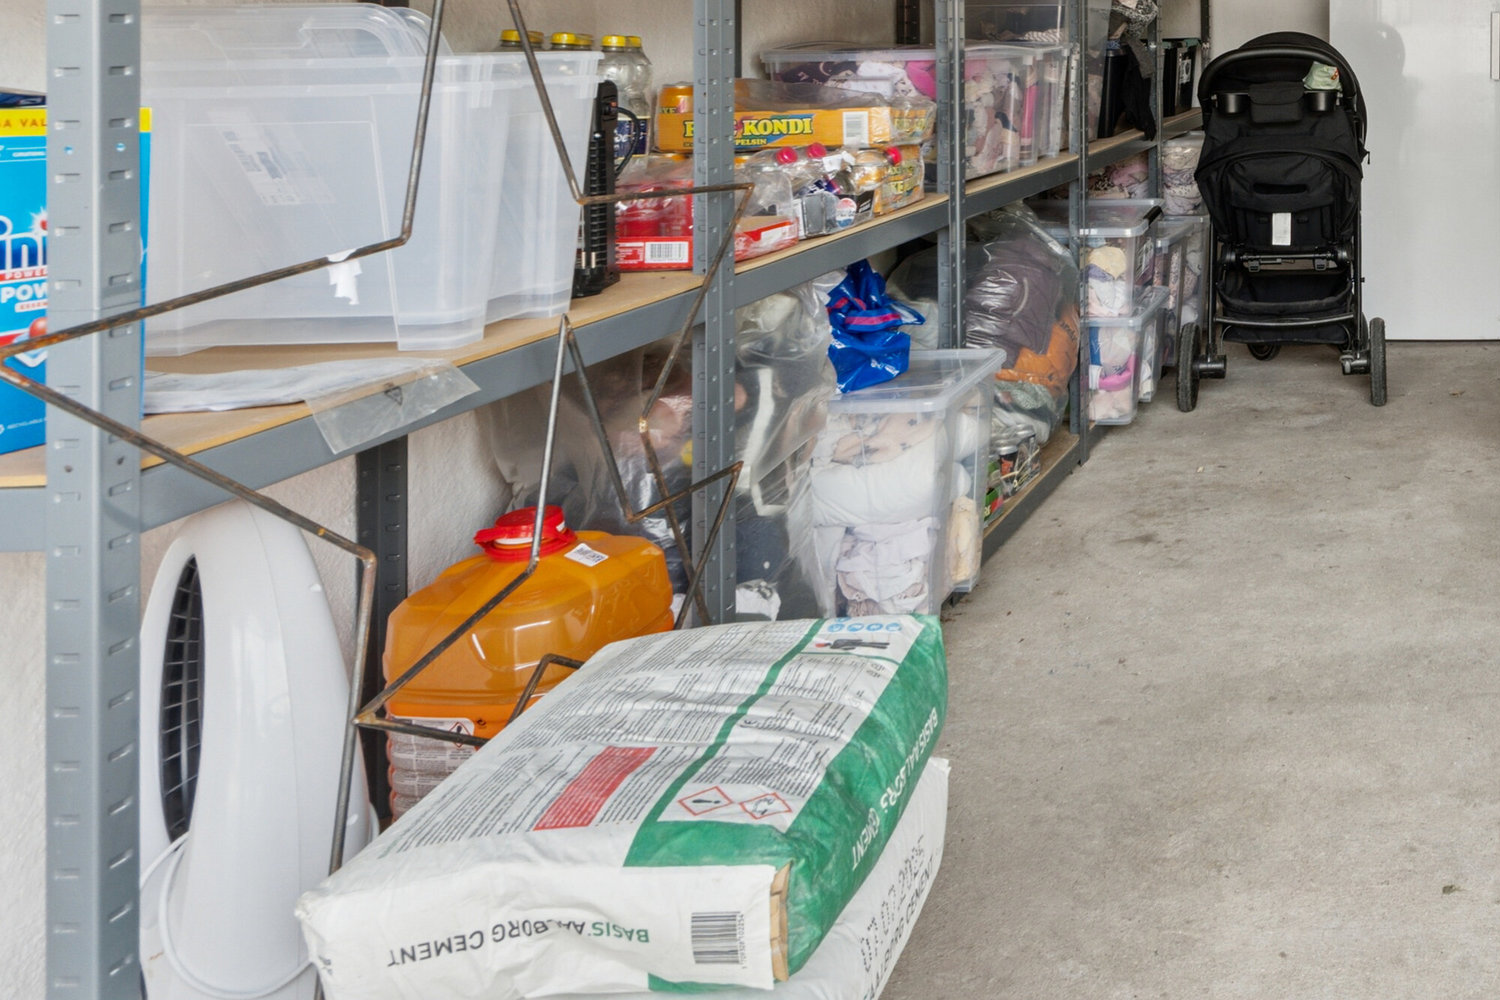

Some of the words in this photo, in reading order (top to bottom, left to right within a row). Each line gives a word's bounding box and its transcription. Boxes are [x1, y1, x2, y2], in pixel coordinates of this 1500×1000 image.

[741, 118, 813, 136] KONDI
[736, 138, 767, 146] PELSIN
[591, 921, 650, 943] BASIS
[387, 933, 484, 967] CEMENT
